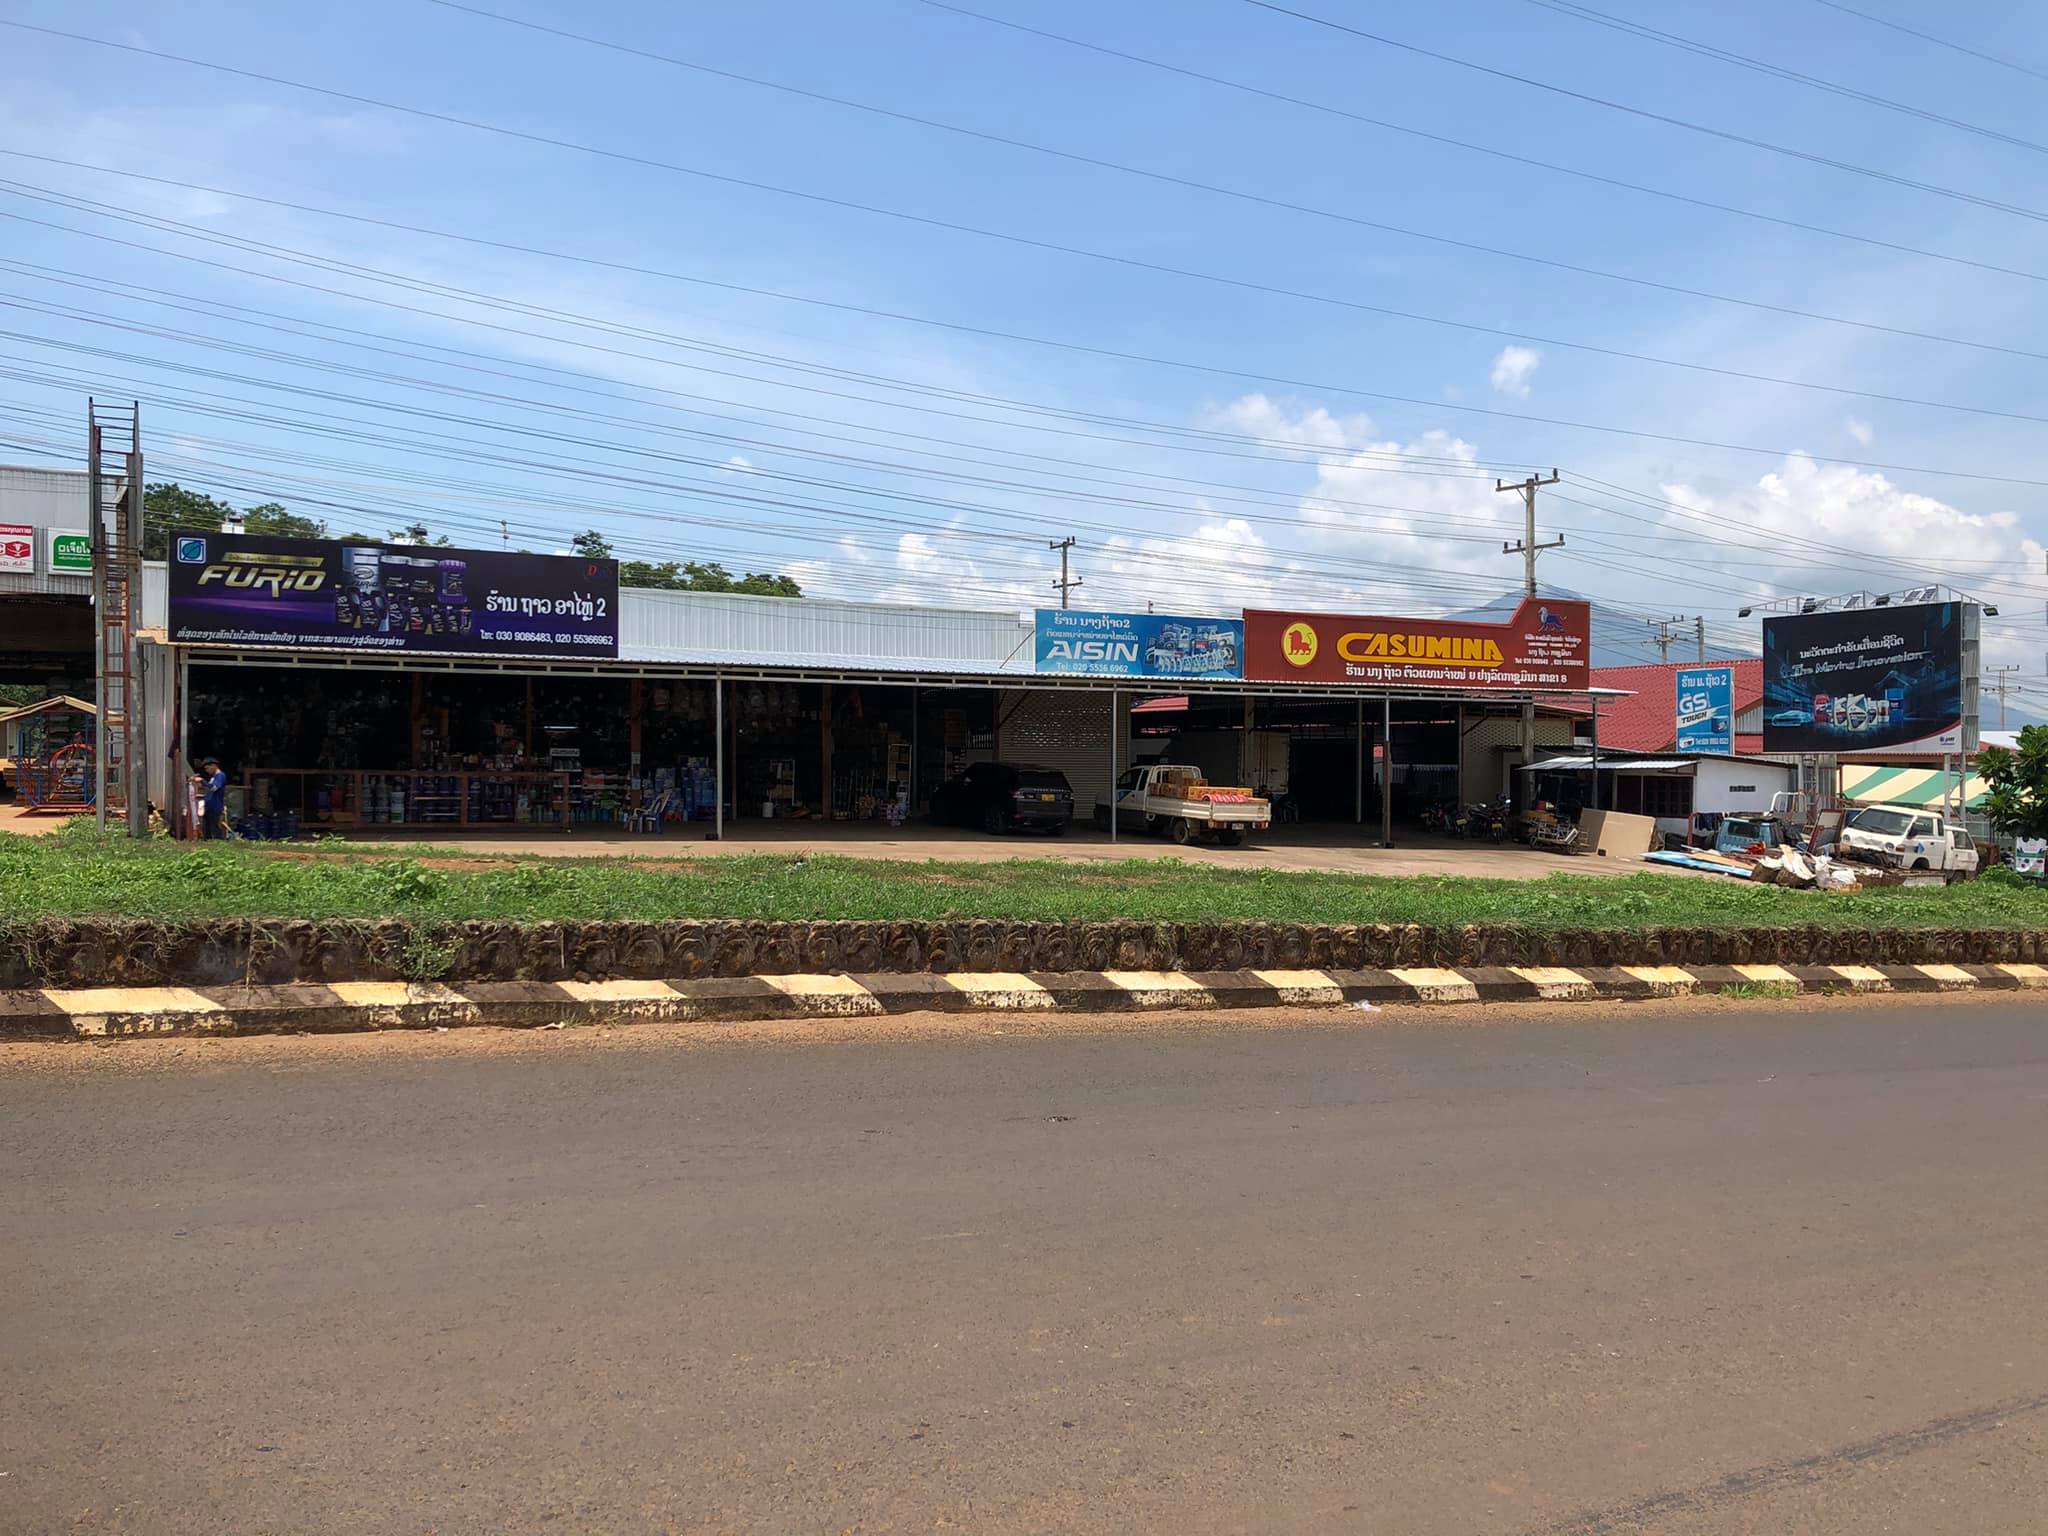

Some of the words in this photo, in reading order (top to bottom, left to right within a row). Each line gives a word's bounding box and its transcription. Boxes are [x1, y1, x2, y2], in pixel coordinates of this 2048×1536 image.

[486, 589, 518, 611] ຮ້ານ
[596, 597, 606, 617] 2
[1054, 612, 1077, 625] ຮ້ານ
[496, 630, 513, 641] 030
[555, 633, 572, 644] 020
[573, 634, 614, 646] 55366962
[1046, 640, 1139, 662] AISIN
[1337, 632, 1505, 668] CASUMINA
[1072, 663, 1087, 672] 020
[1345, 662, 1365, 676] ຮ້ານ
[1367, 667, 1382, 681] ນາງ
[1384, 664, 1402, 681] ຖ້າວ
[1790, 663, 1813, 677] The
[1815, 660, 1855, 675] Moving
[1857, 652, 1926, 670] Innovation
[1721, 674, 1727, 686] 2
[1679, 692, 1708, 714] GS
[1681, 711, 1708, 725] TOUGH
